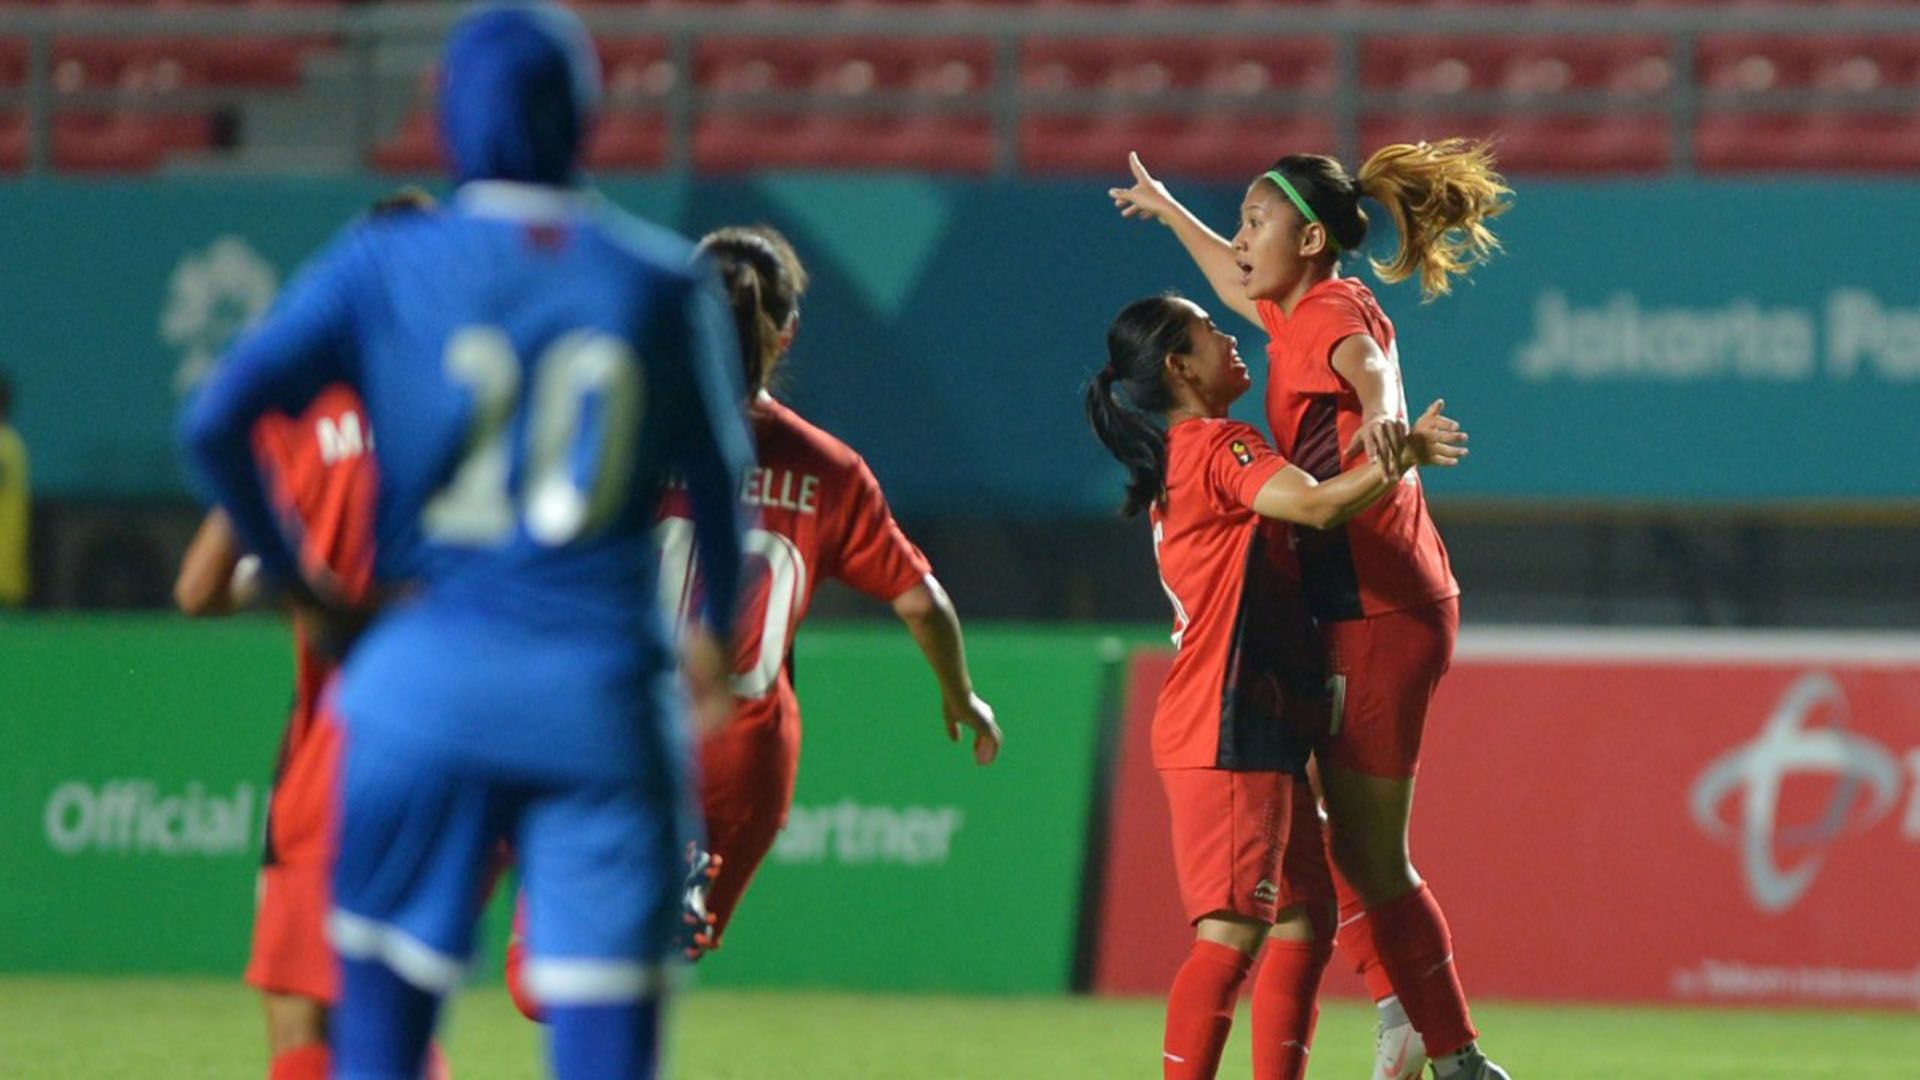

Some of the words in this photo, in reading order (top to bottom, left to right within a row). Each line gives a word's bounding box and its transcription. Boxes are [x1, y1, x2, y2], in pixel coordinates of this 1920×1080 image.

[1515, 291, 1816, 381] Jakarta
[316, 410, 375, 466] M
[419, 324, 645, 546] 20
[737, 466, 820, 513] ELLE
[45, 779, 254, 855] Official
[773, 798, 964, 864] artner
